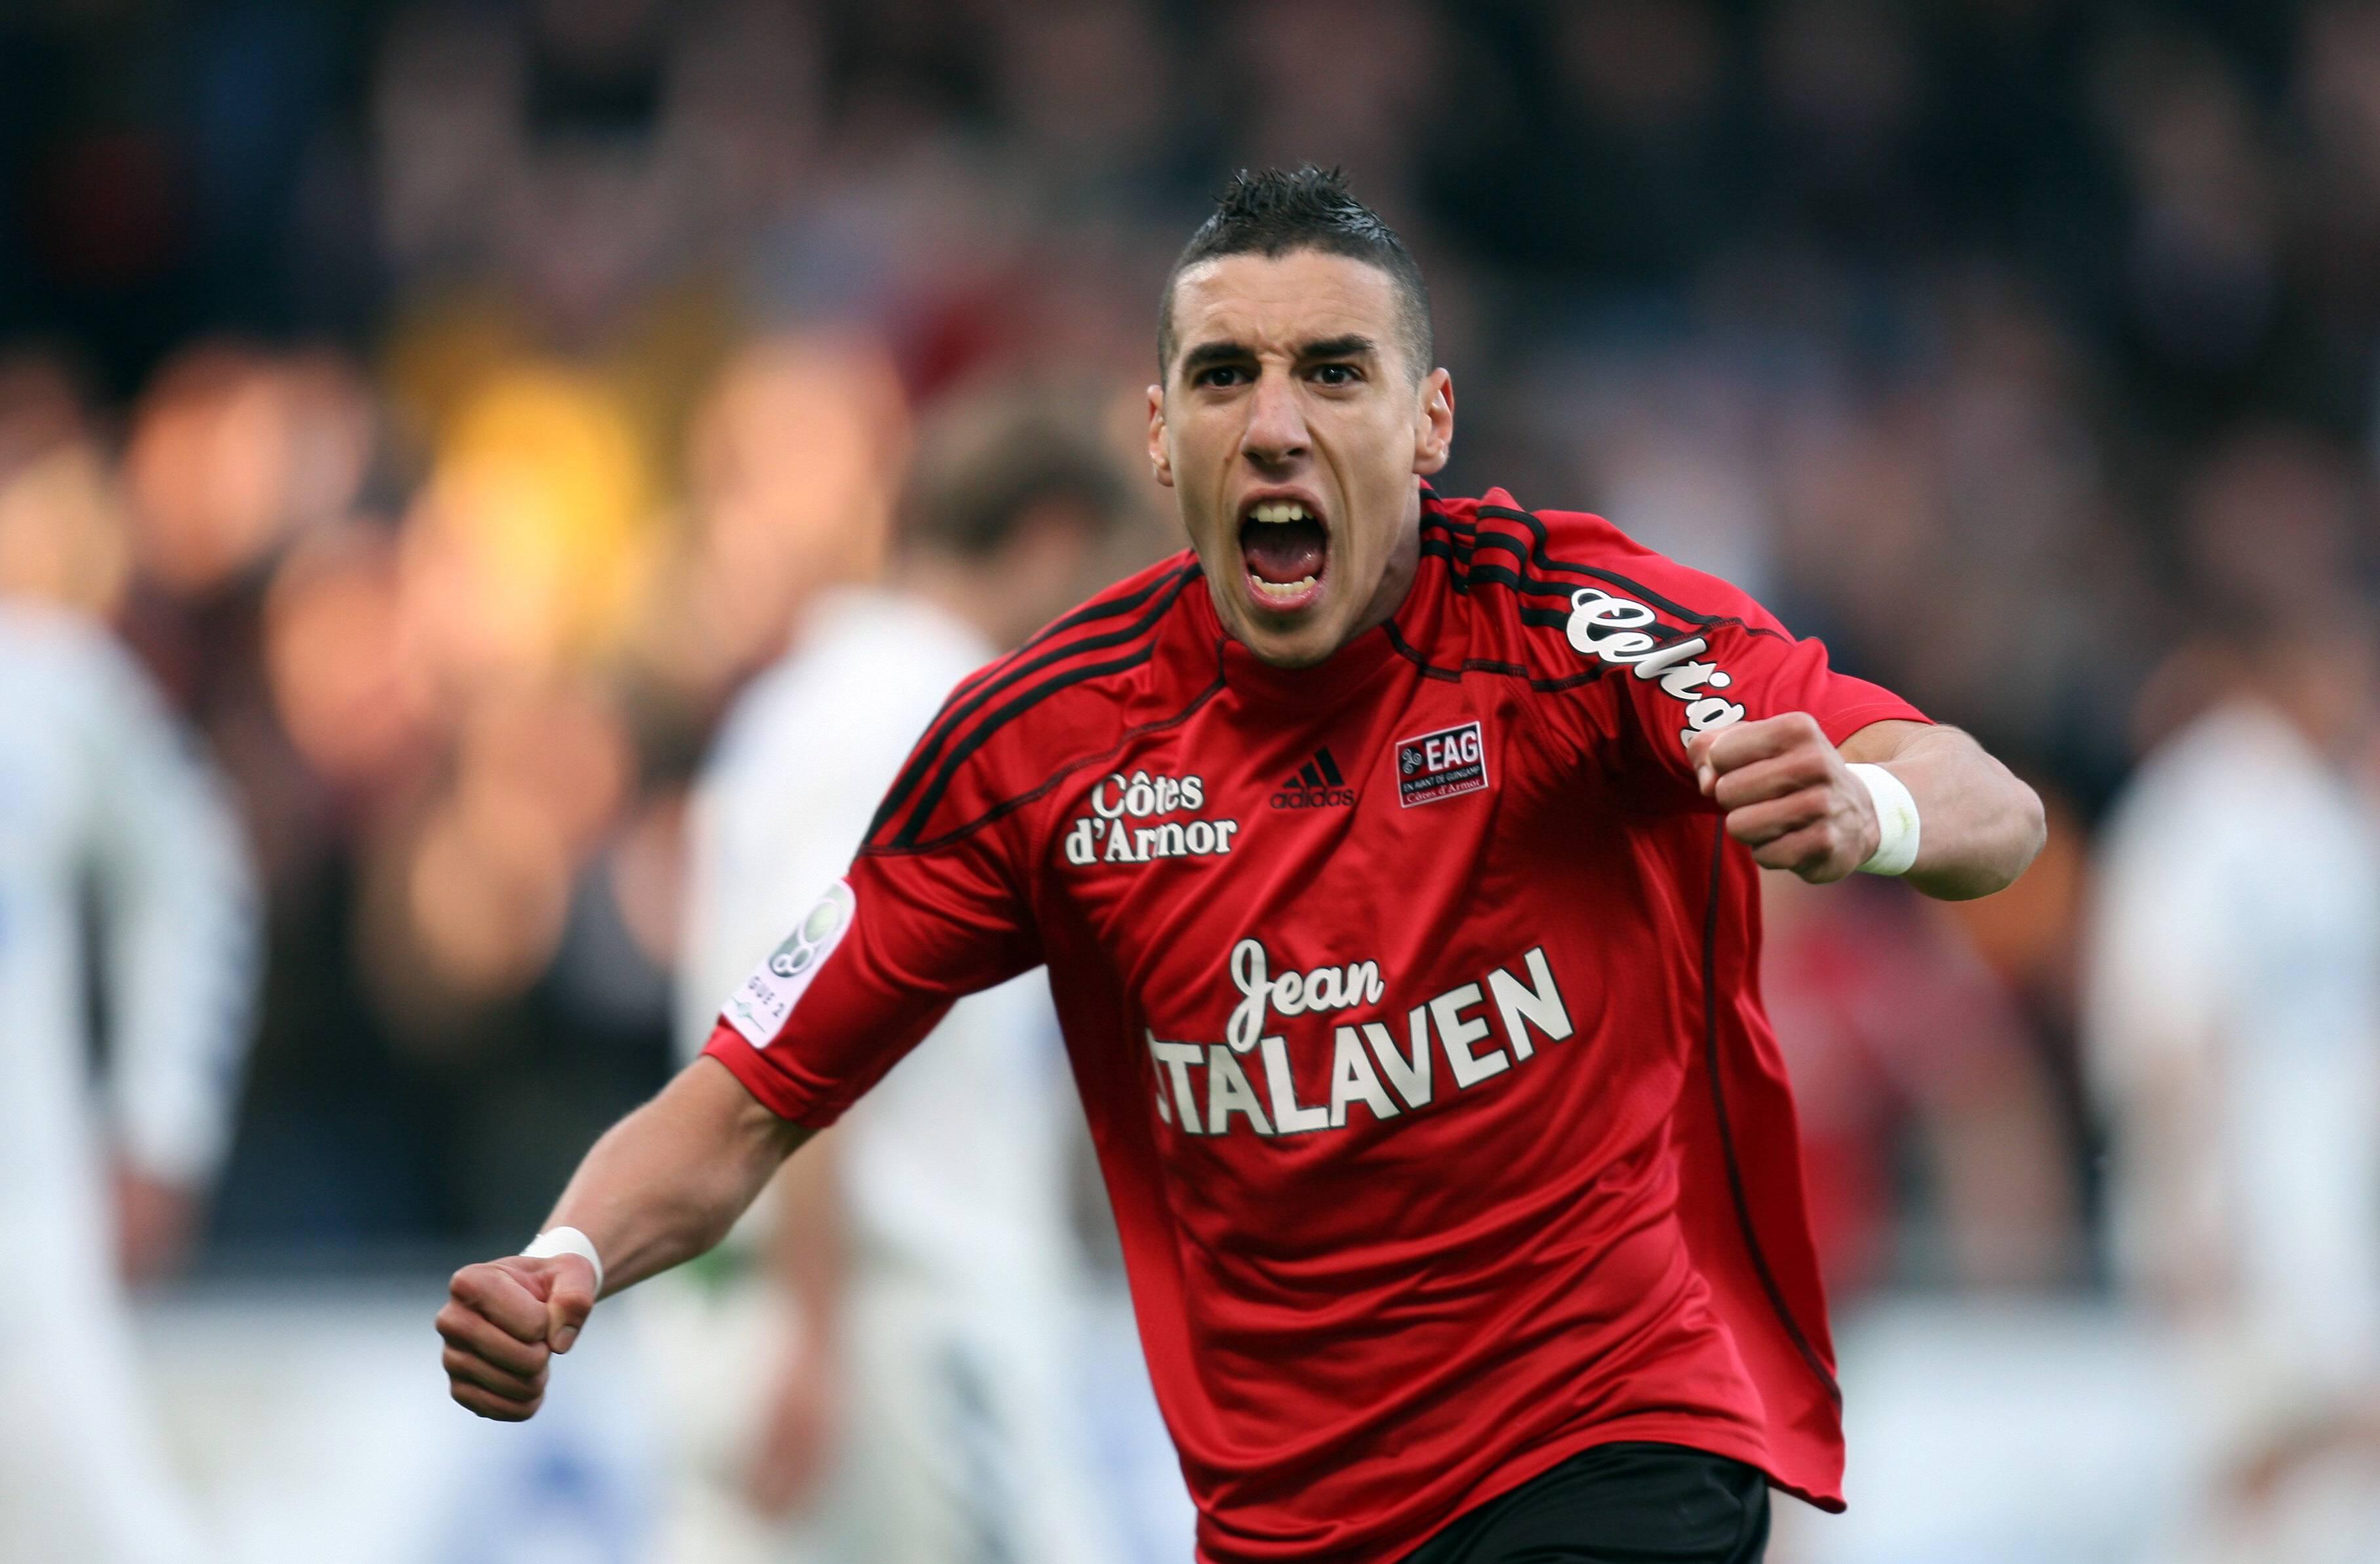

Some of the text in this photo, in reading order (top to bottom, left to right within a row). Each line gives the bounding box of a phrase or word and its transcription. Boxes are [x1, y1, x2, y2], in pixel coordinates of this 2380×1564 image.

[1566, 587, 1745, 749] Celtig
[1425, 730, 1479, 772] EAG
[1090, 770, 1204, 819] Côtes
[1270, 787, 1355, 809] adidas
[1225, 938, 1385, 1053] Jean
